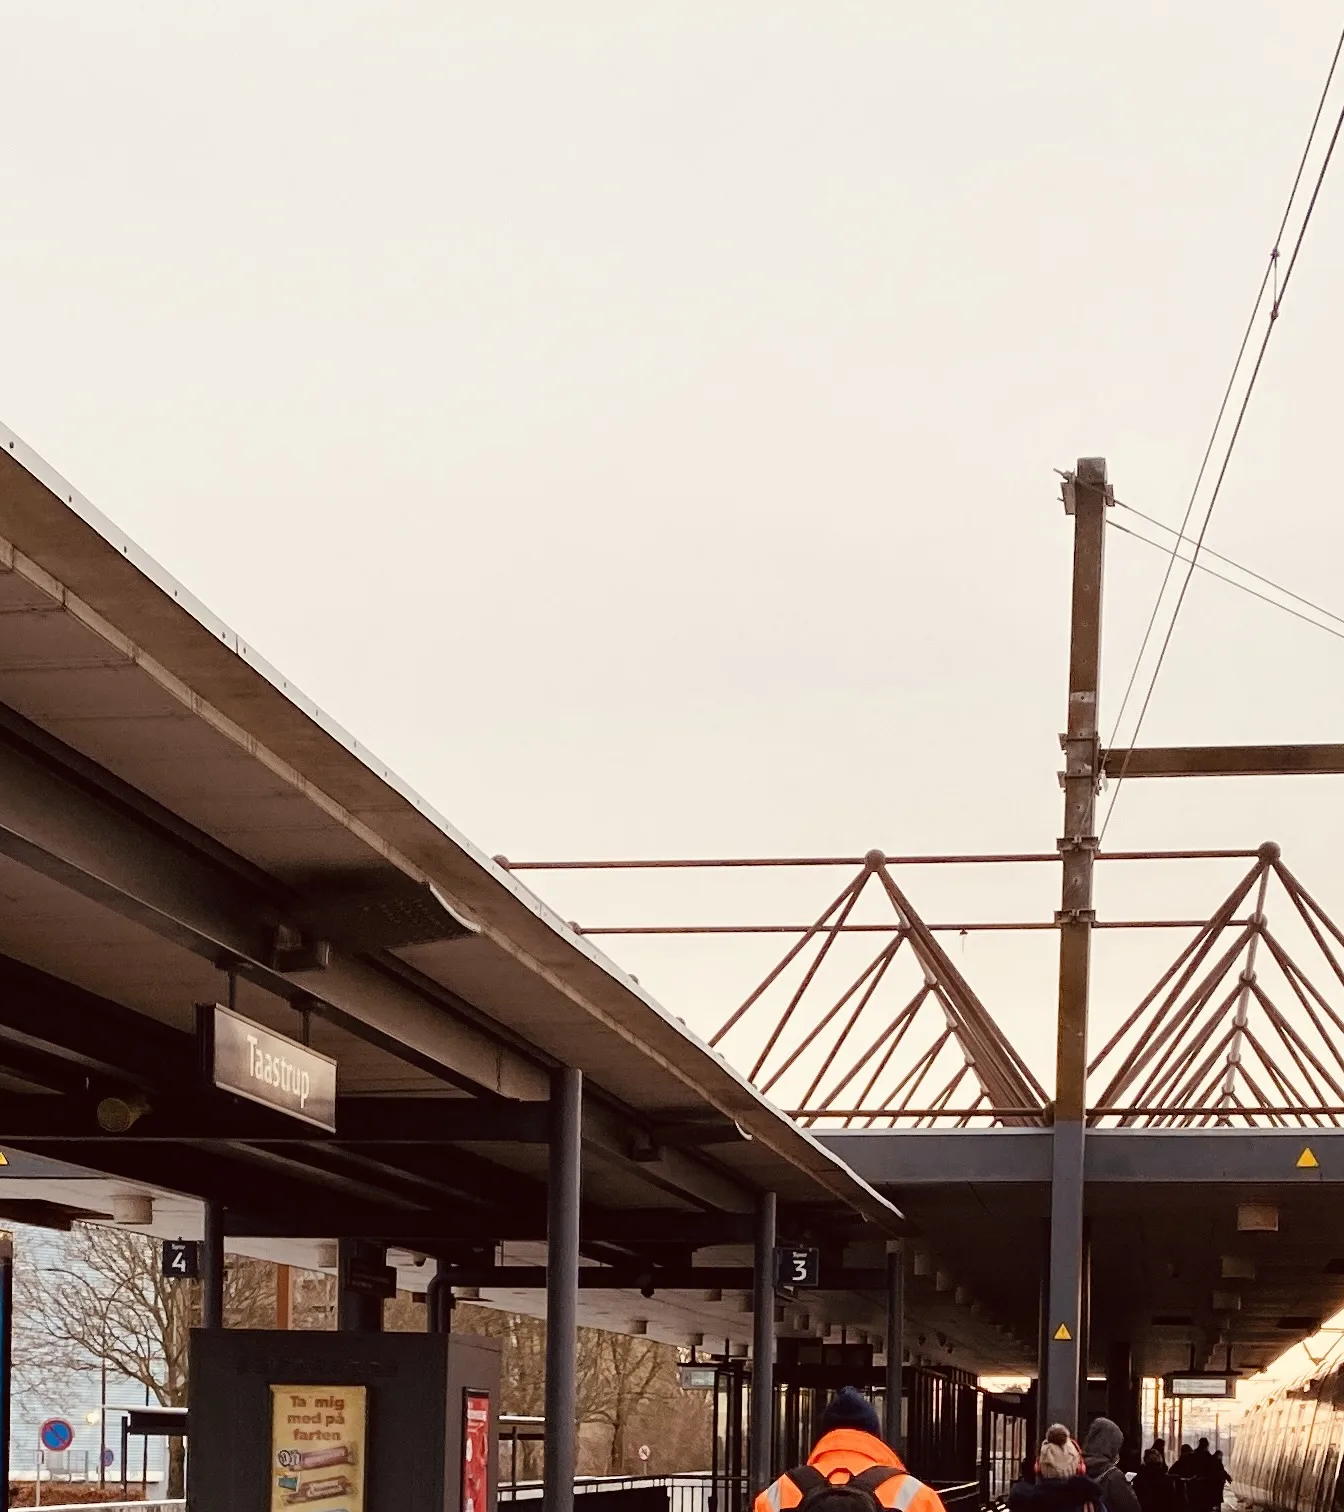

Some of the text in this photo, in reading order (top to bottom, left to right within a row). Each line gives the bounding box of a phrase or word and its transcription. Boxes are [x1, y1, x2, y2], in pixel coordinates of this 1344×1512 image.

[246, 1034, 311, 1109] Taastrup
[171, 1251, 186, 1273] 4
[791, 1259, 807, 1281] 3
[314, 1395, 345, 1411] mig
[287, 1411, 346, 1428] med på
[293, 1428, 342, 1441] farten
